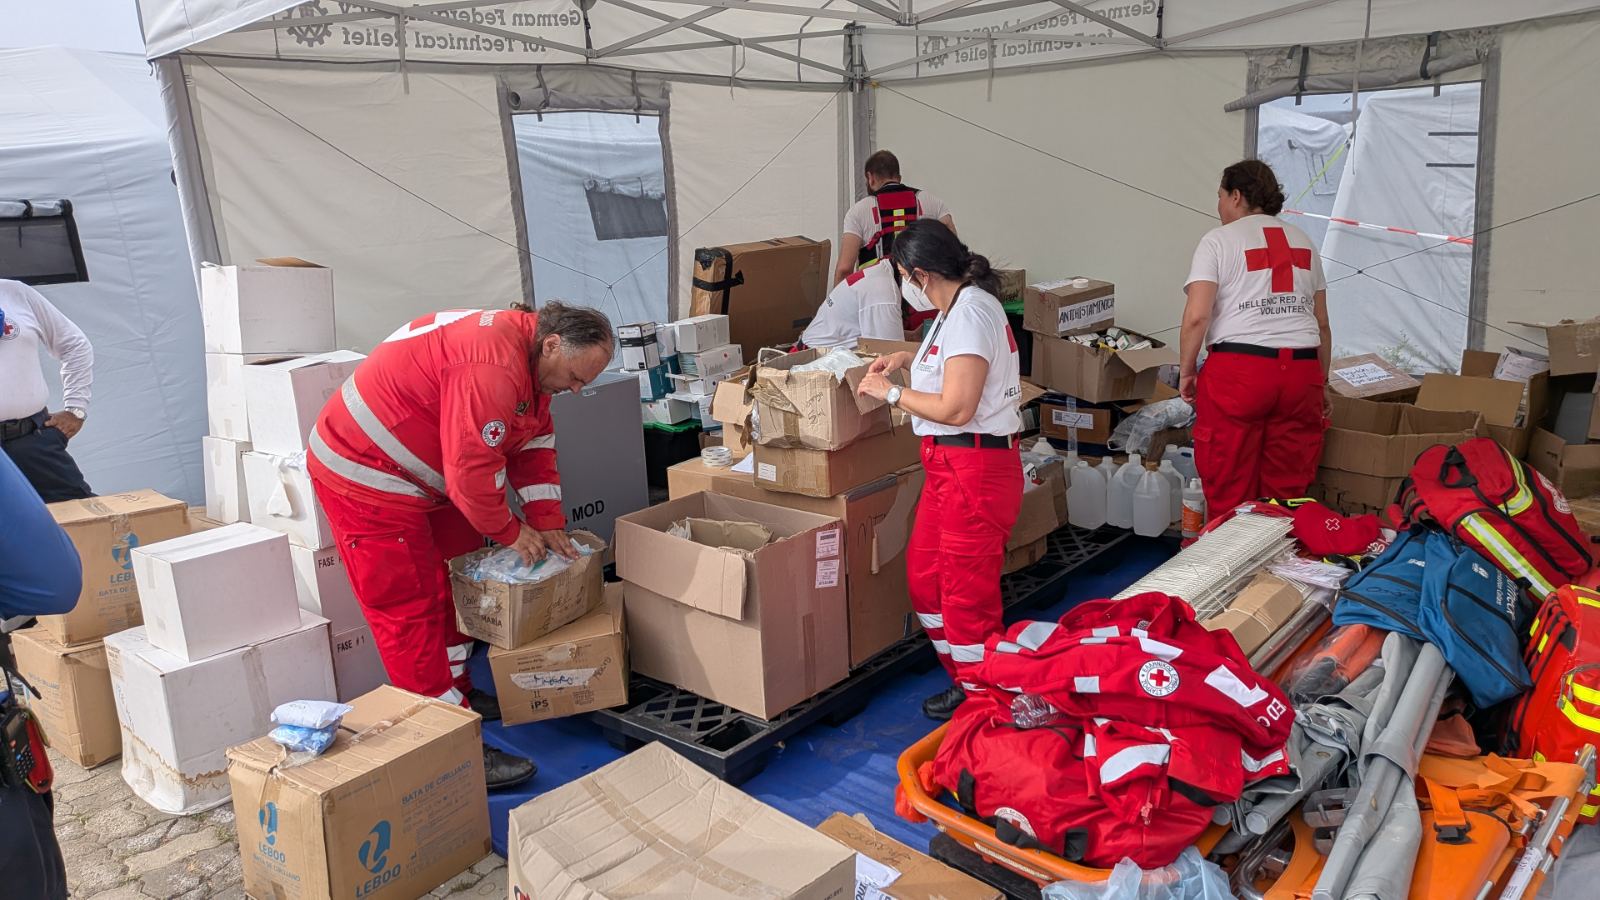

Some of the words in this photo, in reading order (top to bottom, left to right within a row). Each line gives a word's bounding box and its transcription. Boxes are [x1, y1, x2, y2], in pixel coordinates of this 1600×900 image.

[1279, 295, 1297, 304] RED
[1260, 305, 1307, 315] VOLUNTEER
[571, 500, 605, 522] MOD
[318, 556, 335, 569] FASE
[337, 639, 353, 654] FASE
[259, 841, 286, 863] LEBOO
[355, 864, 401, 898] LEBOO
